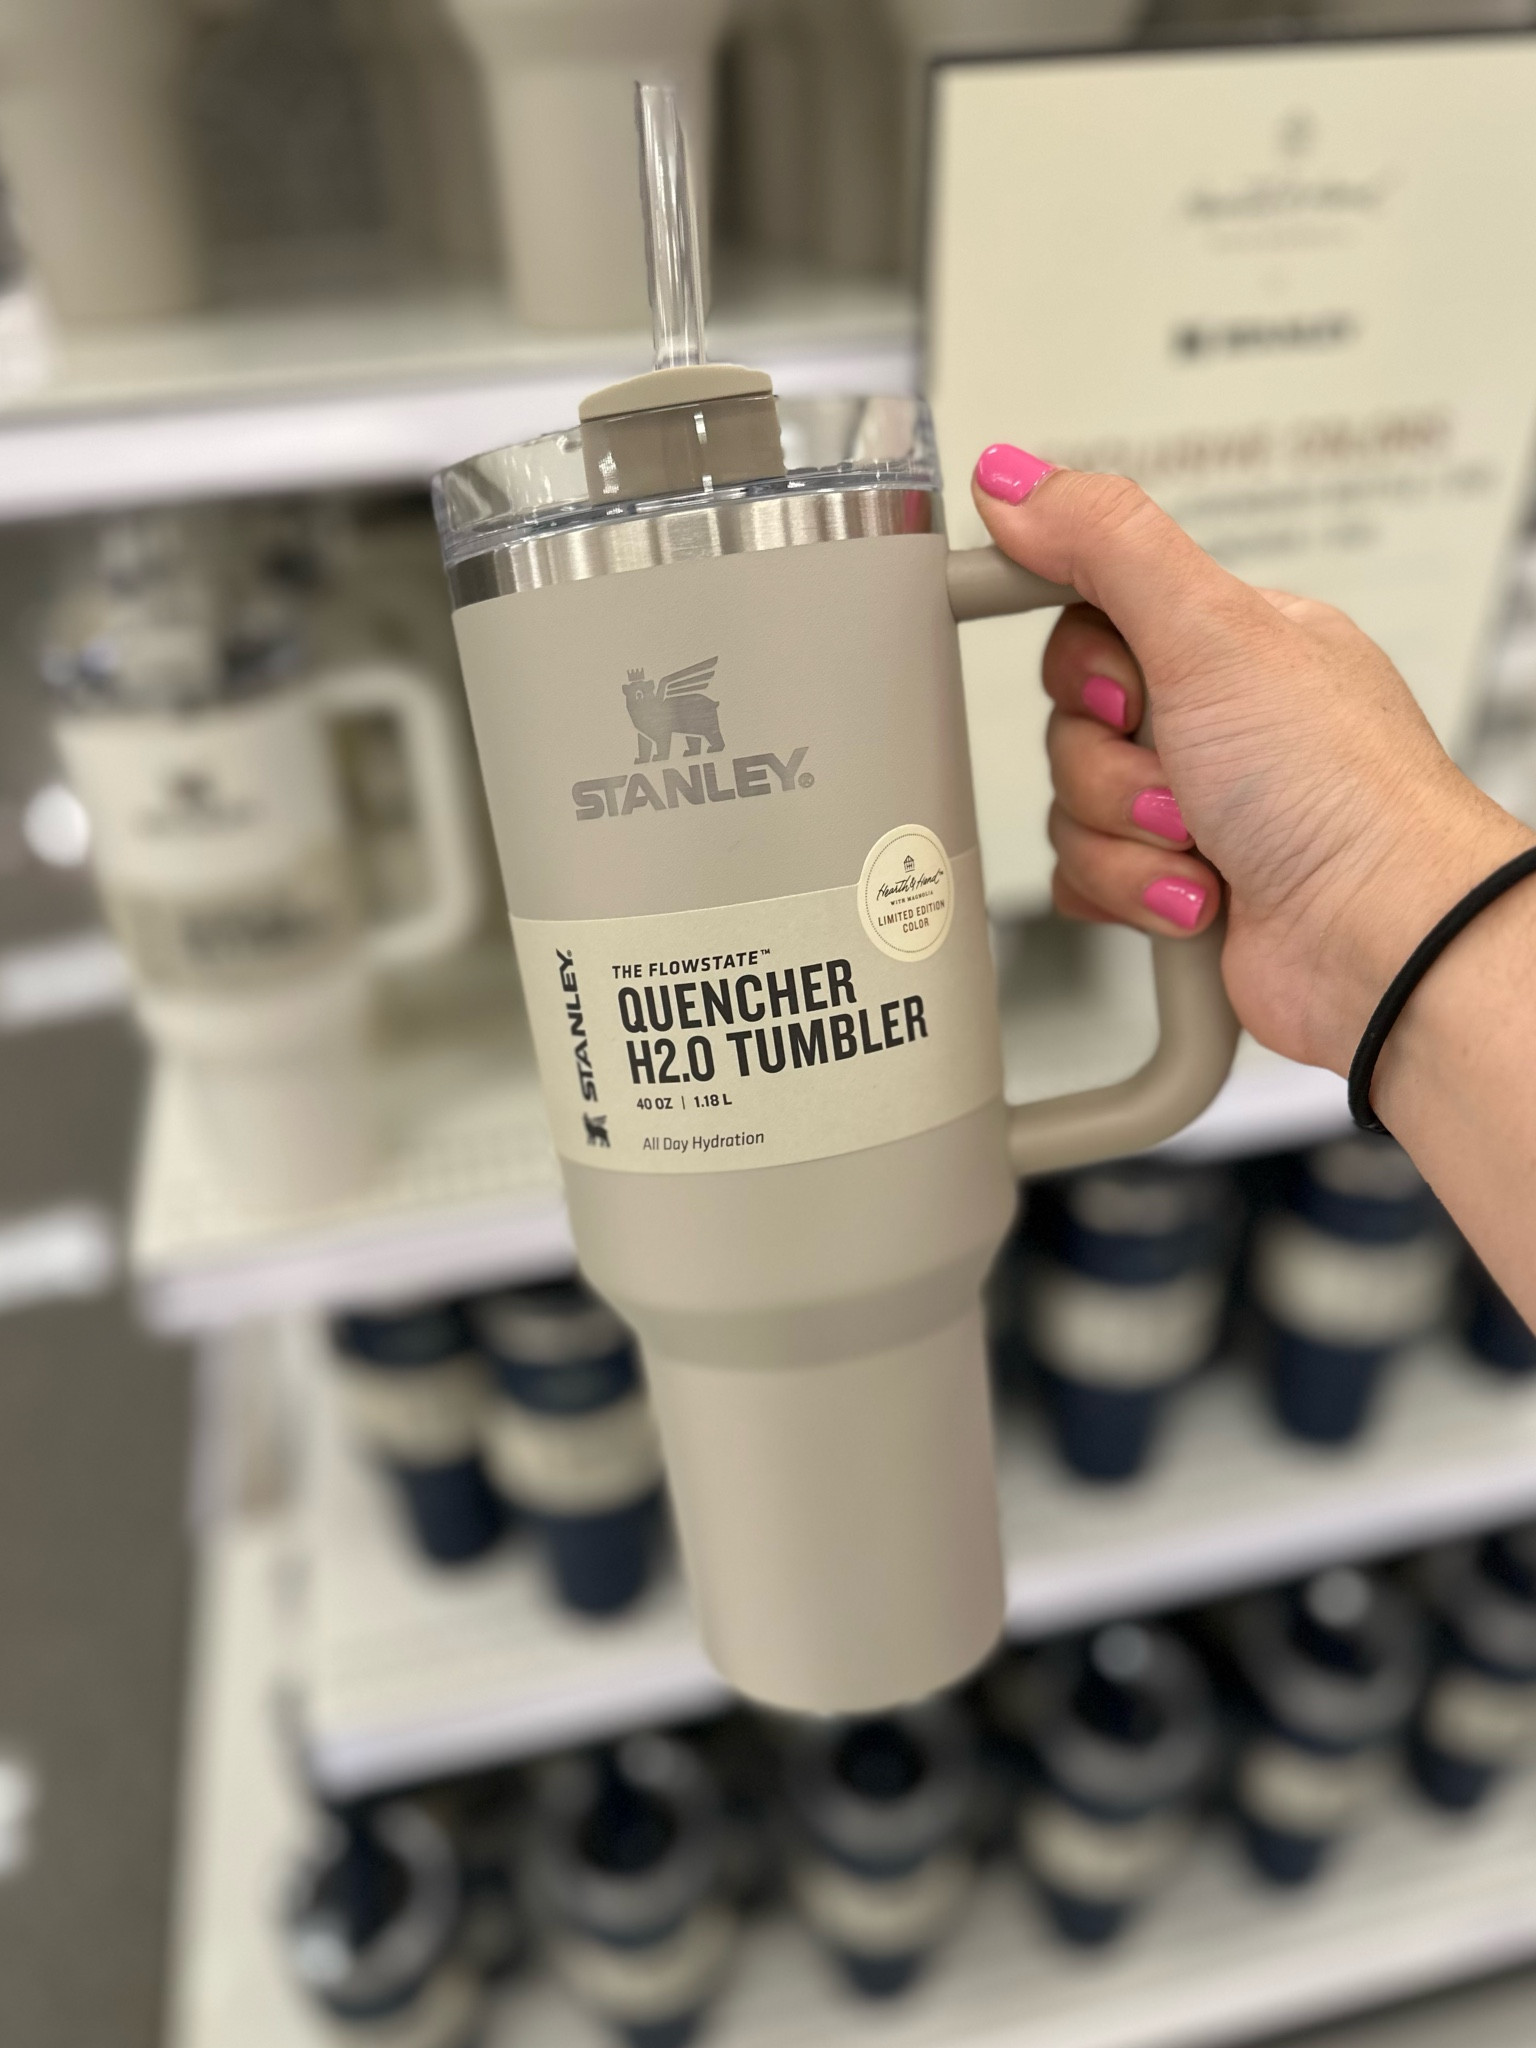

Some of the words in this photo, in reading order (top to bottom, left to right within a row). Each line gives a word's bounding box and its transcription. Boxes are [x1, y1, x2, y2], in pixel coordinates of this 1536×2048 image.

[878, 875, 910, 901] Hearth
[890, 898, 906, 906] WITH
[907, 891, 933, 904] MAGNOLIA
[878, 909, 914, 927] LIMITED
[916, 900, 945, 917] EDITION
[902, 917, 930, 933] COLOR
[612, 963, 642, 979] THE
[618, 959, 857, 1033] QUENCHER
[626, 1035, 716, 1084] H2.0
[727, 995, 929, 1077] TUMBLER
[636, 1098, 653, 1111] 40
[655, 1096, 673, 1110] OZ
[694, 1094, 720, 1109] 1.18
[723, 1093, 733, 1106] L
[642, 1136, 660, 1151] All
[663, 1134, 689, 1154] Day
[692, 1129, 766, 1152] Hydration
